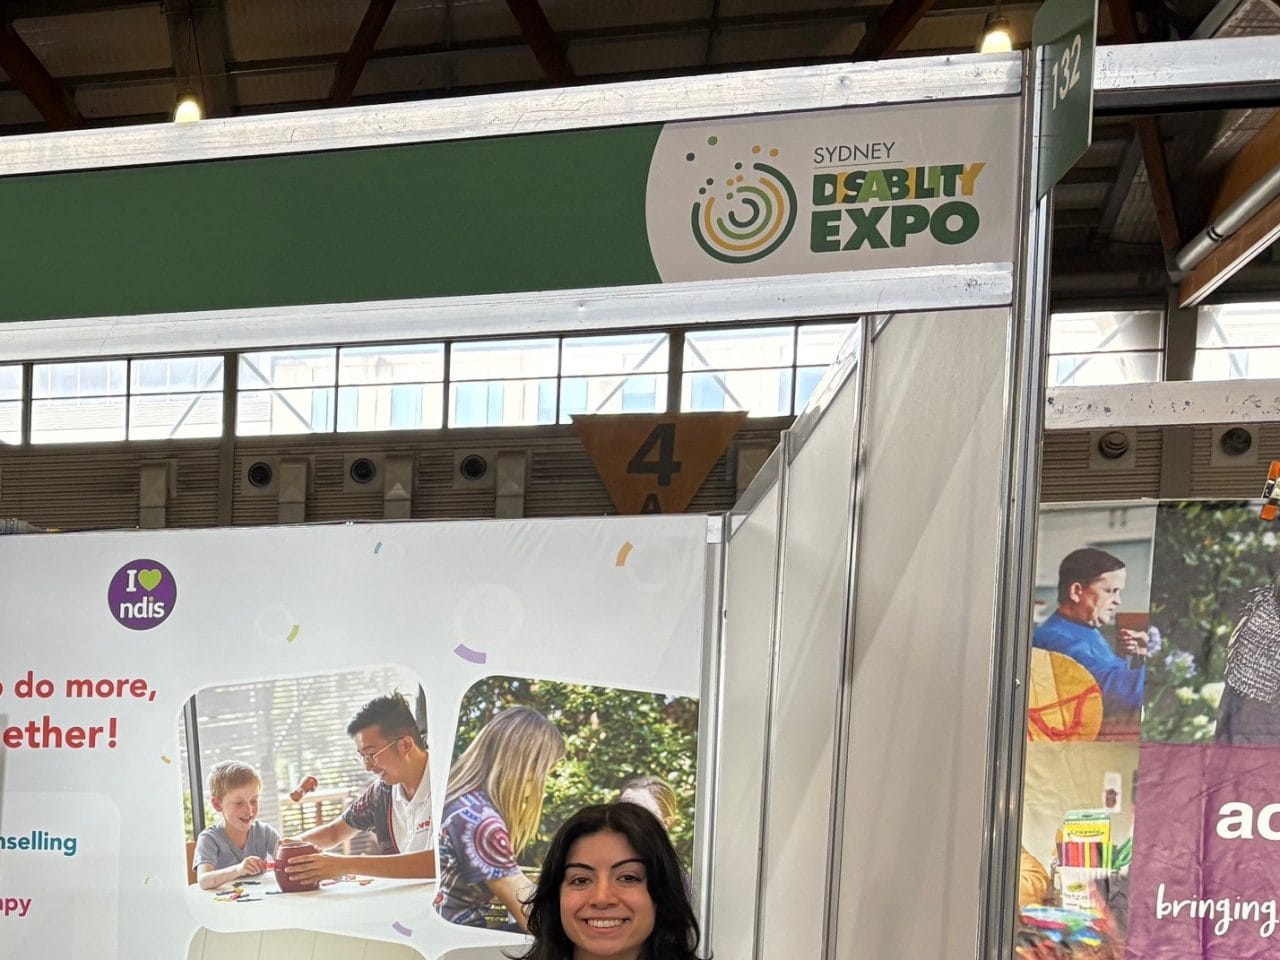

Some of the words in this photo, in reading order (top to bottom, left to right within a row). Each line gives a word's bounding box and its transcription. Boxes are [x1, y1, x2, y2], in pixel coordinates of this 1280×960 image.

[1052, 34, 1081, 110] 132
[814, 142, 895, 164] SYDNEY
[810, 201, 980, 253] EXPO
[626, 423, 682, 487] 4
[126, 569, 136, 592] I
[119, 600, 165, 619] ndis
[14, 671, 54, 698] do
[66, 679, 156, 701] more,
[1156, 883, 1279, 937] bringing
